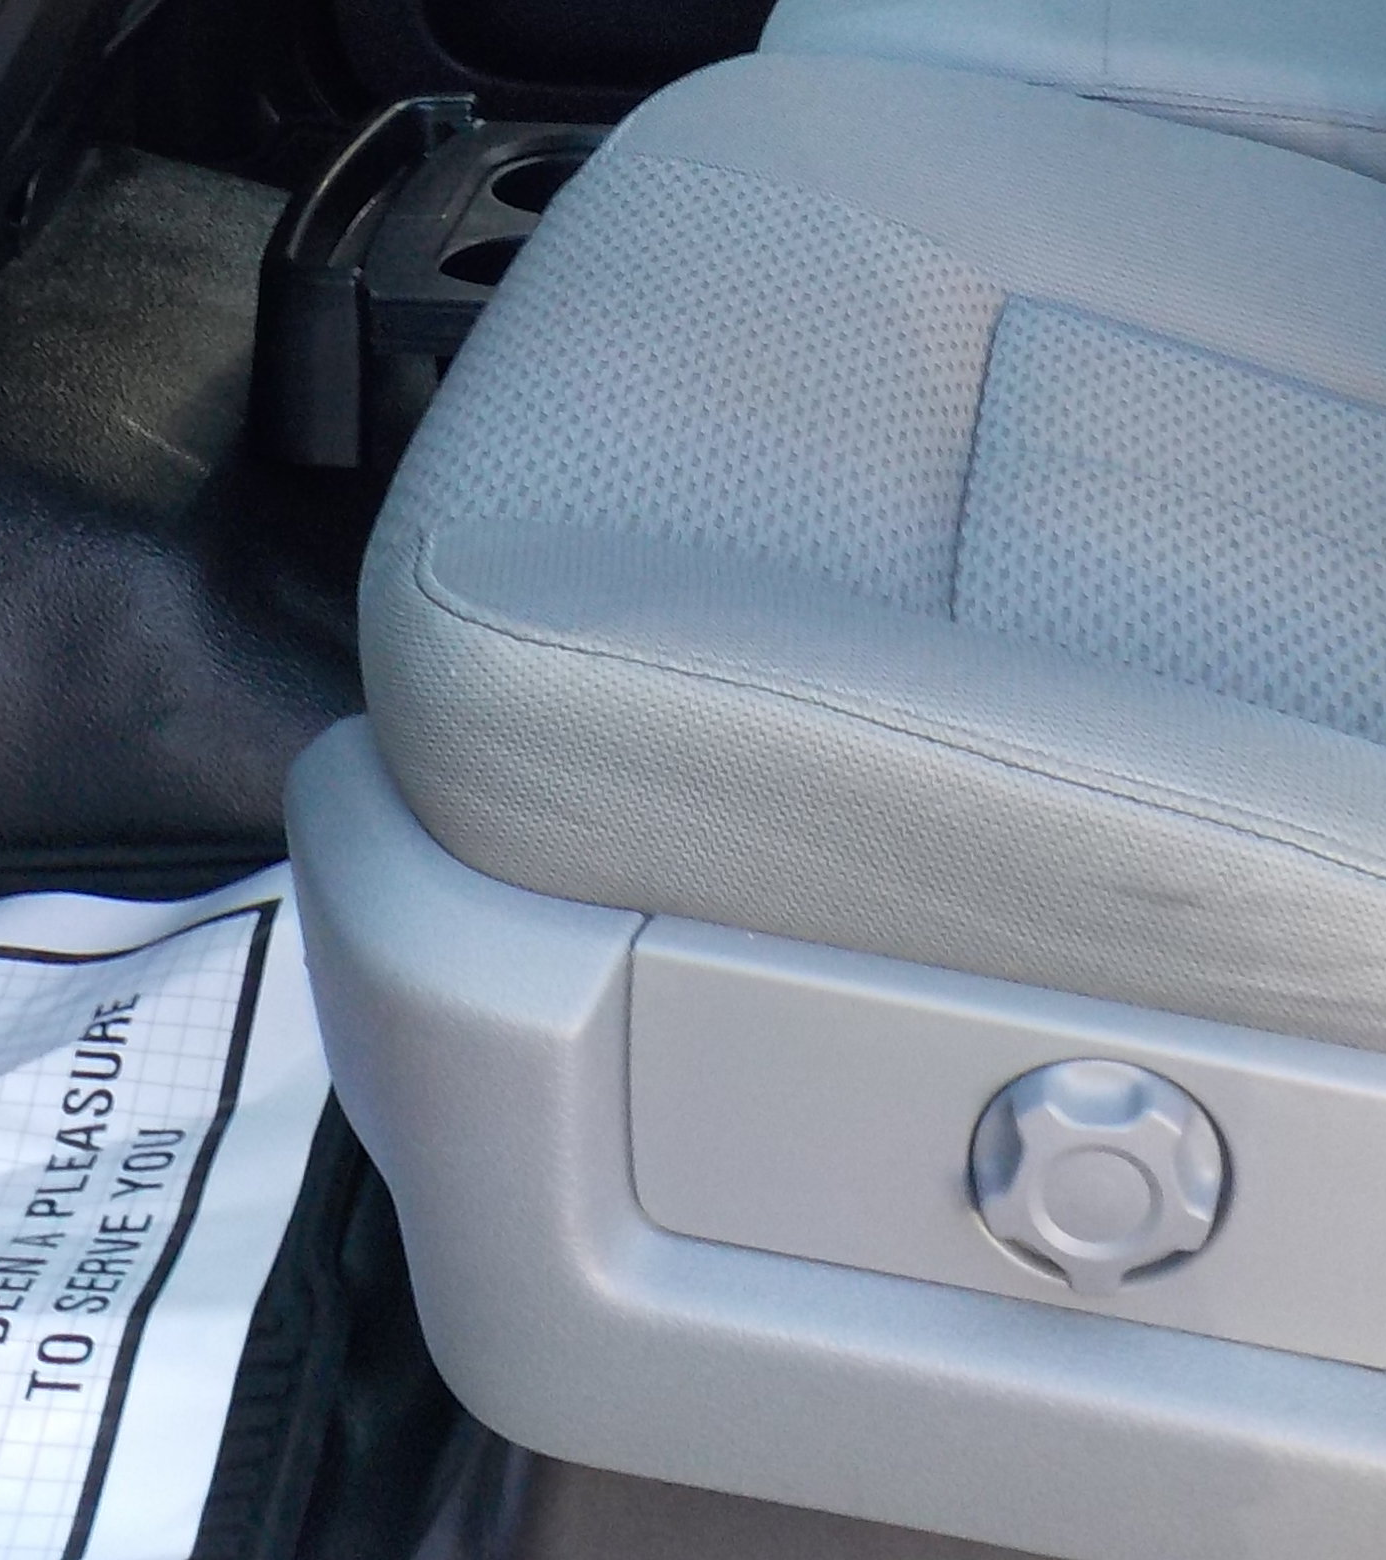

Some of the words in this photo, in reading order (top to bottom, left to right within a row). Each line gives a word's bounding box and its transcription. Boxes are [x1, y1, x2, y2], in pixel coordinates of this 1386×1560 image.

[25, 992, 142, 1218] PLEASURE
[118, 1126, 187, 1205] YOU
[11, 1232, 66, 1249] A
[53, 1213, 154, 1316] SERVE
[25, 1331, 95, 1402] TO
